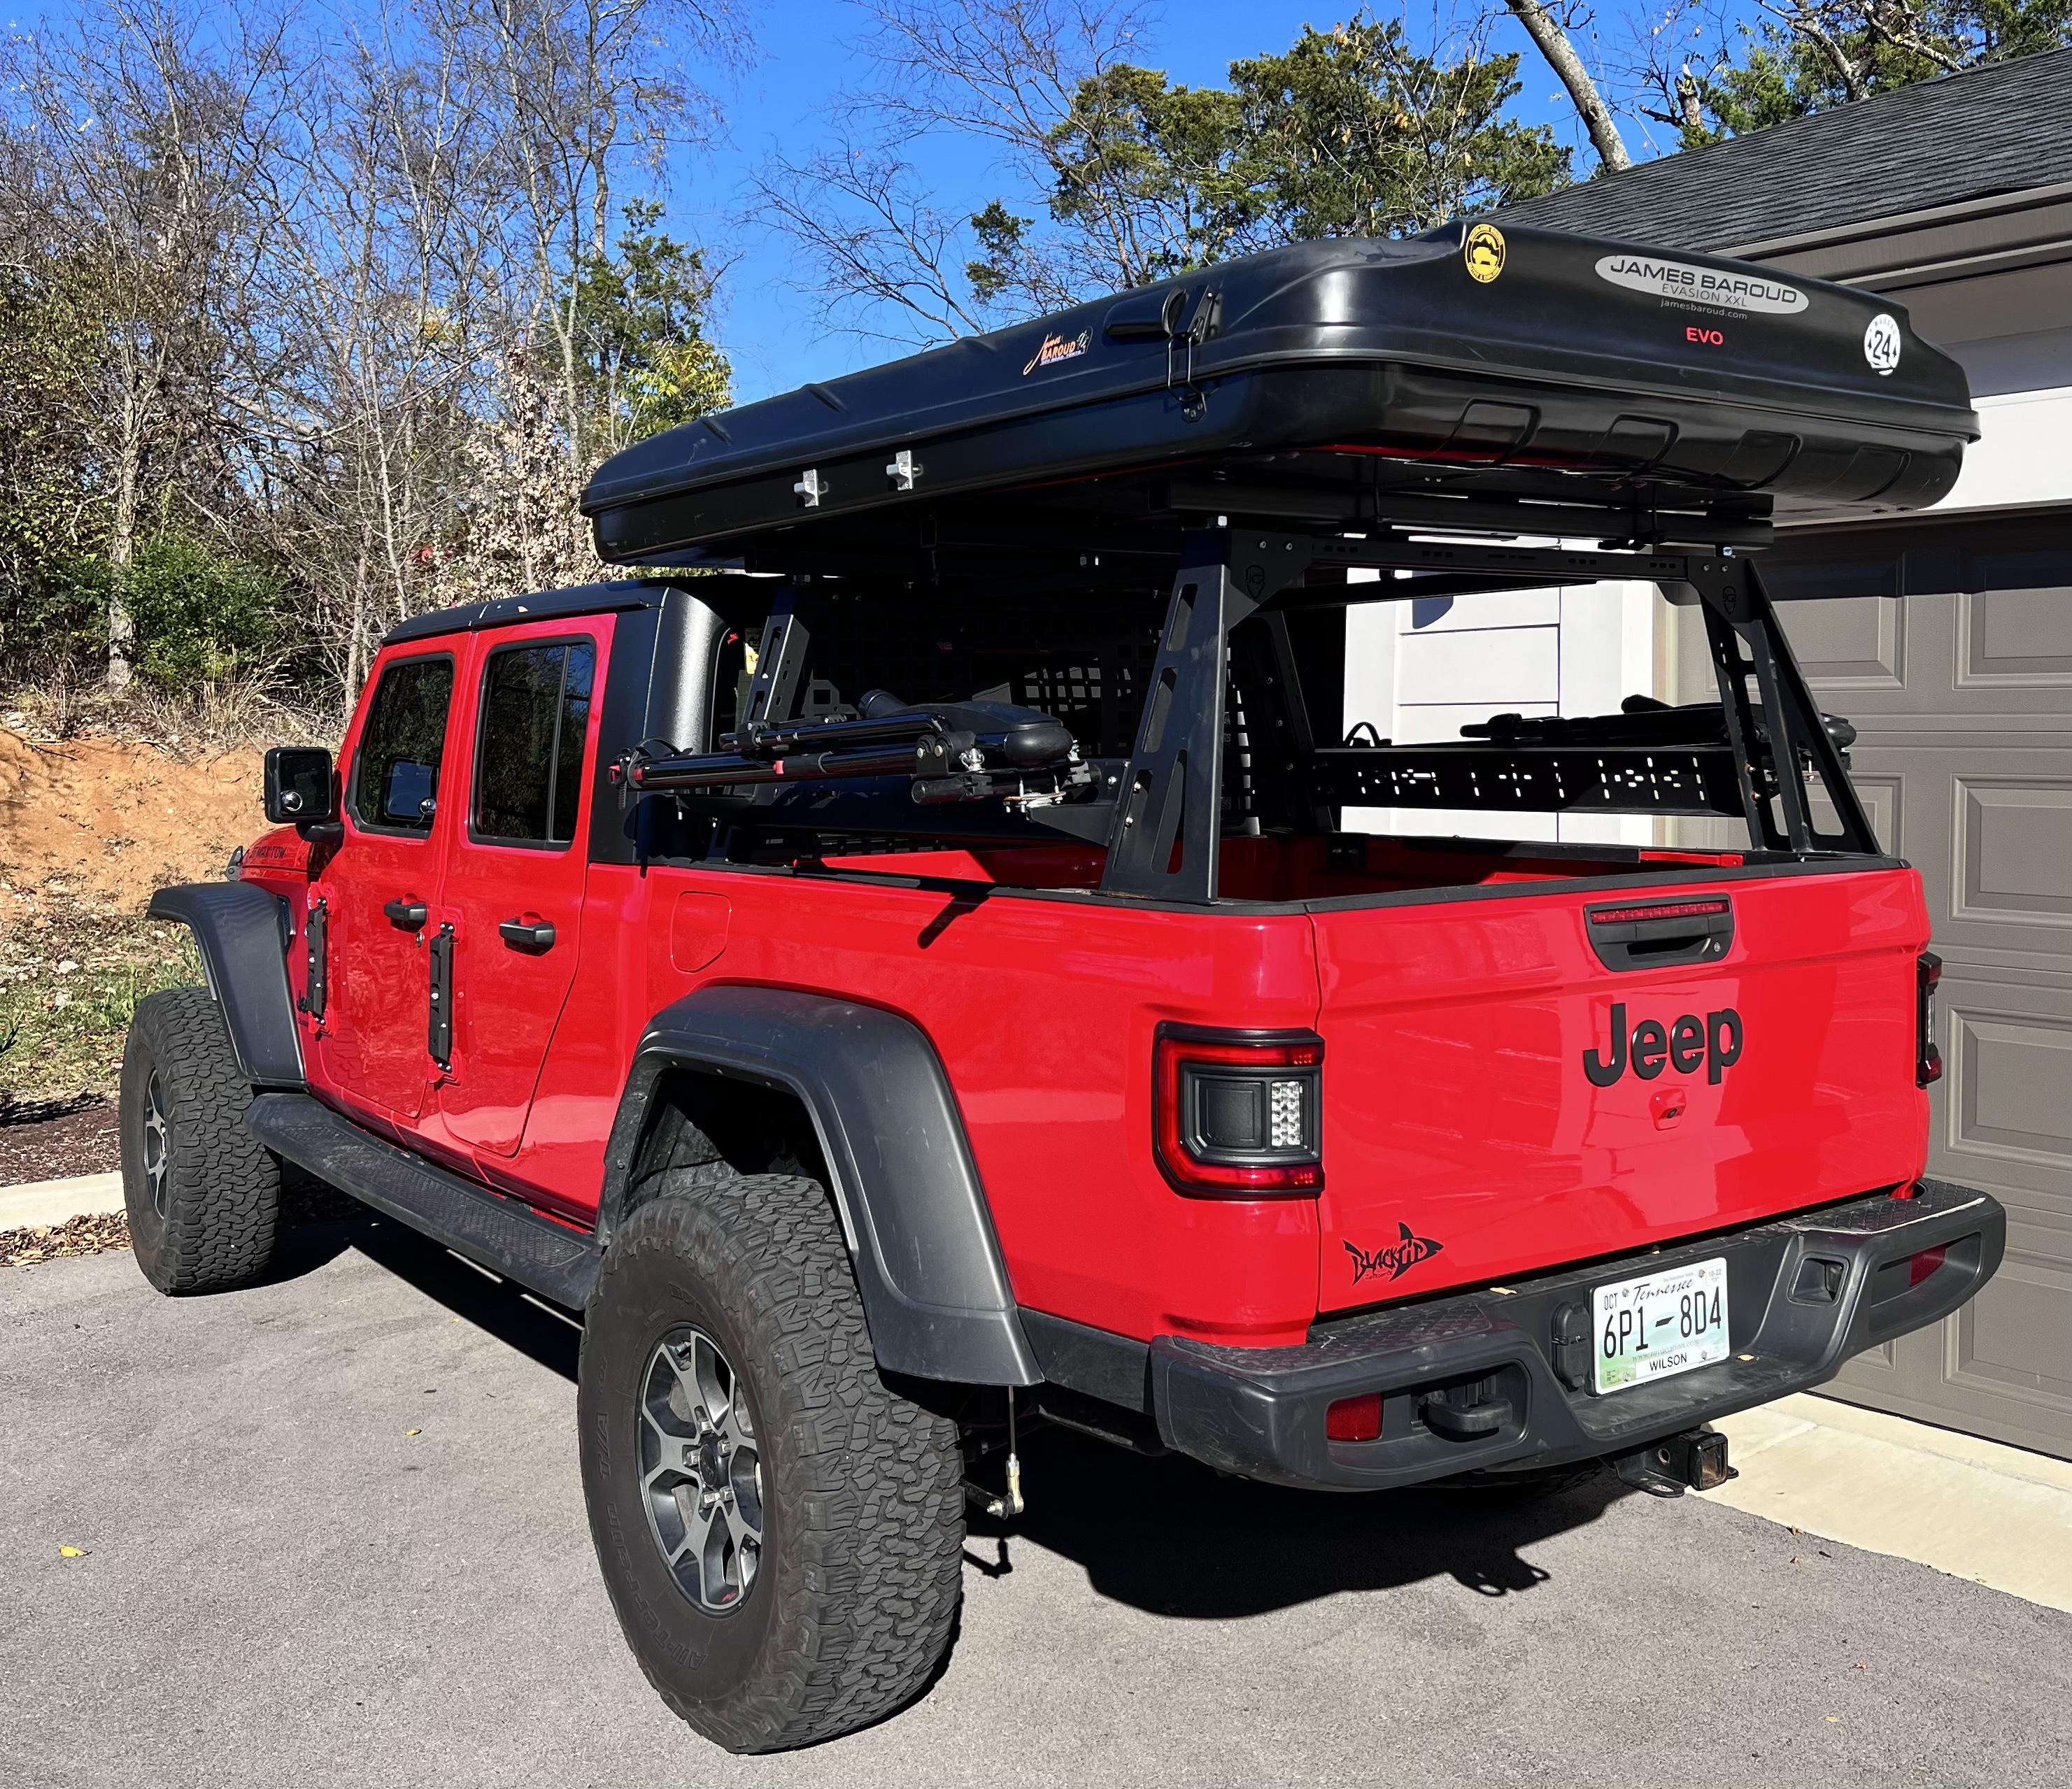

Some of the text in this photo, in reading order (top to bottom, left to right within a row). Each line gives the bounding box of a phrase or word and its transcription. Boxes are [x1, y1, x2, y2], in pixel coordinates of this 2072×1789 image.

[1610, 259, 1797, 304] JAMES BAROUD
[1662, 283, 1747, 307] EVASION XXL
[1660, 298, 1747, 320] jamesbaroud.com
[1686, 327, 1724, 345] EVO
[1873, 329, 1892, 363] 24
[1040, 341, 1076, 361] BAROUD
[1583, 1002, 1743, 1087] Jeep
[1604, 1293, 1618, 1311] OCT
[1633, 1278, 1694, 1306] Tennessee
[1603, 1286, 1722, 1359] 6P1 8D4
[1649, 1352, 1687, 1371] WILSON
